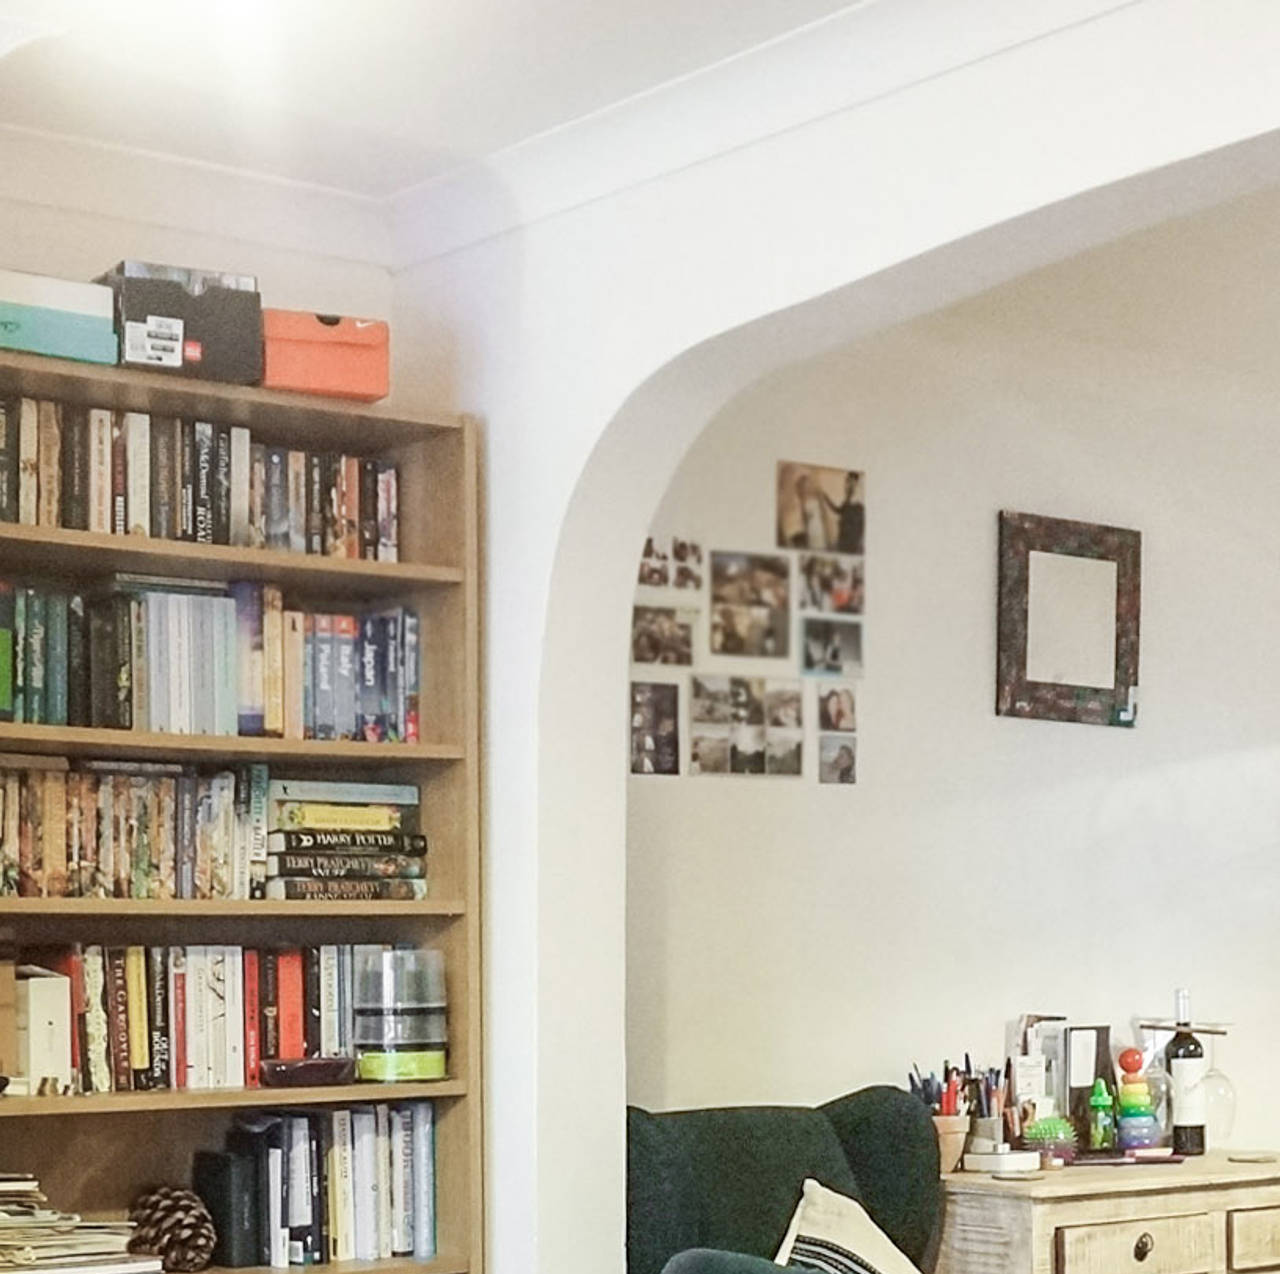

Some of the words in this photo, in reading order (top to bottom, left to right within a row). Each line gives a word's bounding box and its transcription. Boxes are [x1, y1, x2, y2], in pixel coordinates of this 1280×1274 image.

[318, 644, 331, 691] Poland
[338, 644, 354, 676] Italy
[362, 640, 379, 686] Japan
[317, 833, 352, 846] HARRY
[355, 833, 395, 846] POTTER
[286, 856, 314, 869] TERRY
[114, 957, 124, 986] THE
[117, 990, 128, 1068] GARGOYLE
